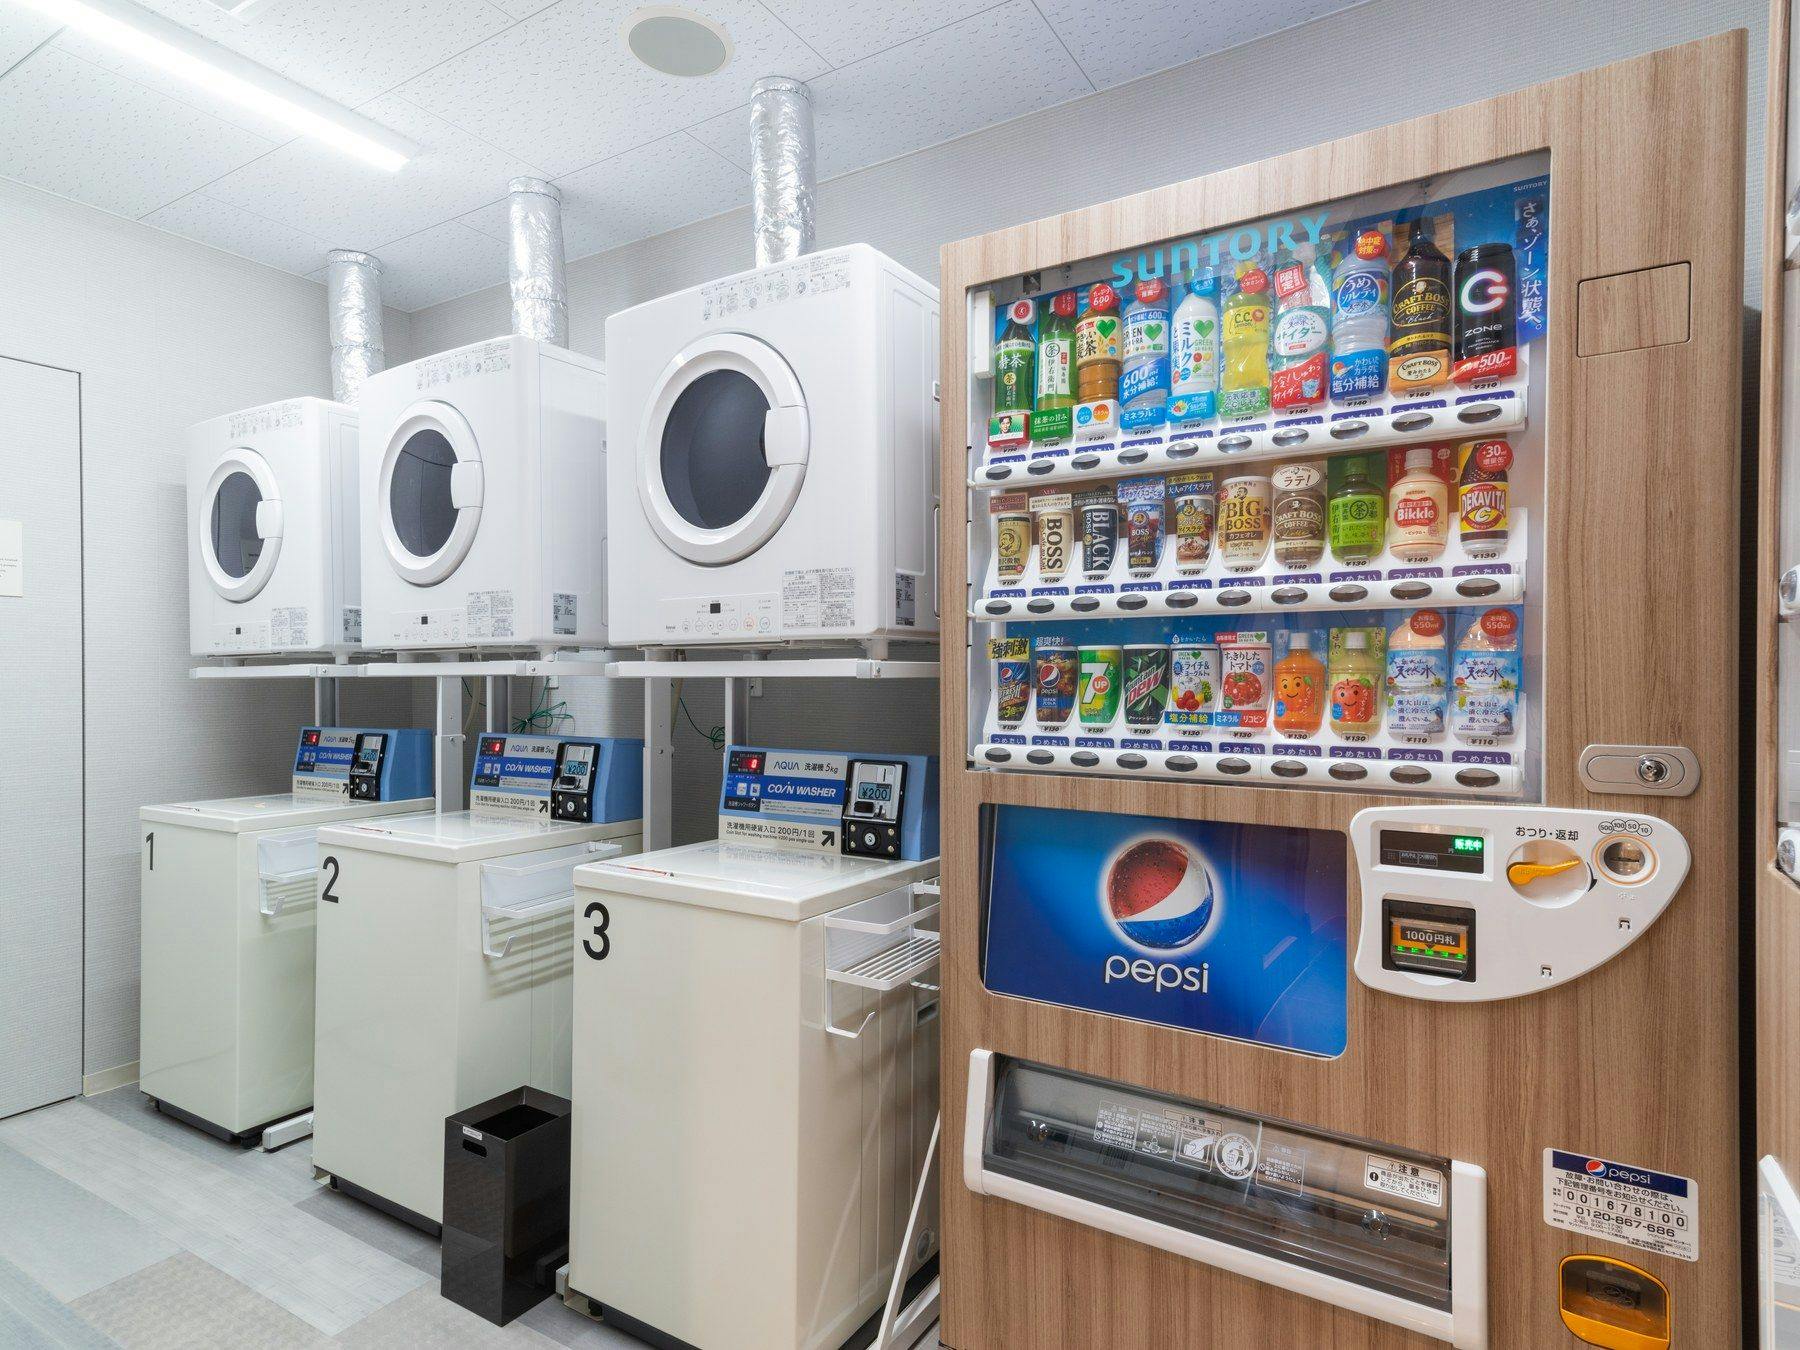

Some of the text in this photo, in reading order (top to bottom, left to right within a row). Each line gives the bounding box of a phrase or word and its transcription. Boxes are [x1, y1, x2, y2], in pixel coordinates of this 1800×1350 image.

[1513, 180, 1548, 192] SUNTORY
[1518, 202, 1544, 330] さぁ、ゾーン状態へ。
[1346, 276, 1371, 290] うめ
[1093, 295, 1110, 306] 600
[1341, 288, 1377, 305] ソルティ
[1394, 294, 1424, 314] CRAFT
[1406, 304, 1436, 315] COFFEE
[1234, 312, 1252, 324] C.C.
[1180, 322, 1194, 368] ミルク
[1402, 360, 1439, 372] CRAFT BOSS
[1332, 376, 1380, 394] 塩分補給
[1474, 382, 1498, 390] ¥210
[1273, 384, 1300, 401] サイダー
[1284, 474, 1312, 488] ラテ!
[1168, 483, 1212, 494] 大人のアイスラテ
[1226, 500, 1262, 519] BIG
[1462, 490, 1506, 516] DEKAVITA
[1276, 510, 1322, 525] CRAFT BOSS
[1398, 507, 1435, 521] Bikkle
[1226, 518, 1261, 531] BOSS
[1284, 520, 1308, 529] COFFEE
[1046, 518, 1064, 570] BOSS
[1092, 512, 1110, 571] BLACK
[1414, 621, 1439, 629] 550ml
[1036, 636, 1064, 646] 超爽快!
[1224, 651, 1261, 661] すっきりした
[1184, 662, 1210, 670] ライチ&
[1230, 661, 1252, 670] トマト
[1394, 666, 1437, 679] 天然水
[1466, 666, 1505, 681] 天然水
[1081, 662, 1110, 704] 7
[1094, 680, 1108, 688] UP
[1168, 713, 1209, 724] 塩分補給
[1244, 715, 1265, 724] リコピン
[510, 744, 528, 752] AQUA
[545, 745, 554, 754] 5kg
[1334, 750, 1377, 758] つめたい
[333, 752, 353, 761] WASHER
[1393, 752, 1438, 760] つめたい
[1458, 755, 1506, 764] つめたい
[524, 765, 552, 774] WASHER
[566, 764, 586, 776] ¥200
[752, 759, 758, 768] 0
[774, 761, 800, 771] AQUA
[804, 762, 824, 772] 洗濯機
[825, 763, 838, 774] 5kg
[796, 786, 836, 798] WASHER
[862, 786, 888, 800] ¥200
[510, 797, 536, 807] 200円/1回
[726, 822, 815, 839] 洗濯機用硬貨入口 200円/1回
[1516, 826, 1580, 842] おつり・返却
[1454, 838, 1483, 851] 販売中
[145, 832, 155, 871] 1
[322, 856, 340, 904] 2
[582, 902, 611, 961] 3
[1405, 930, 1456, 946] 1000円札
[1104, 954, 1210, 994] pepsi
[1398, 1164, 1420, 1177] 注意
[1608, 1168, 1651, 1184] pepsi
[1564, 1172, 1674, 1203] 故障・お問い合わせの際は、
[1556, 1176, 1685, 1214] 下記管理番号をお知らせください。
[1576, 1206, 1676, 1238] 0120-867-686
